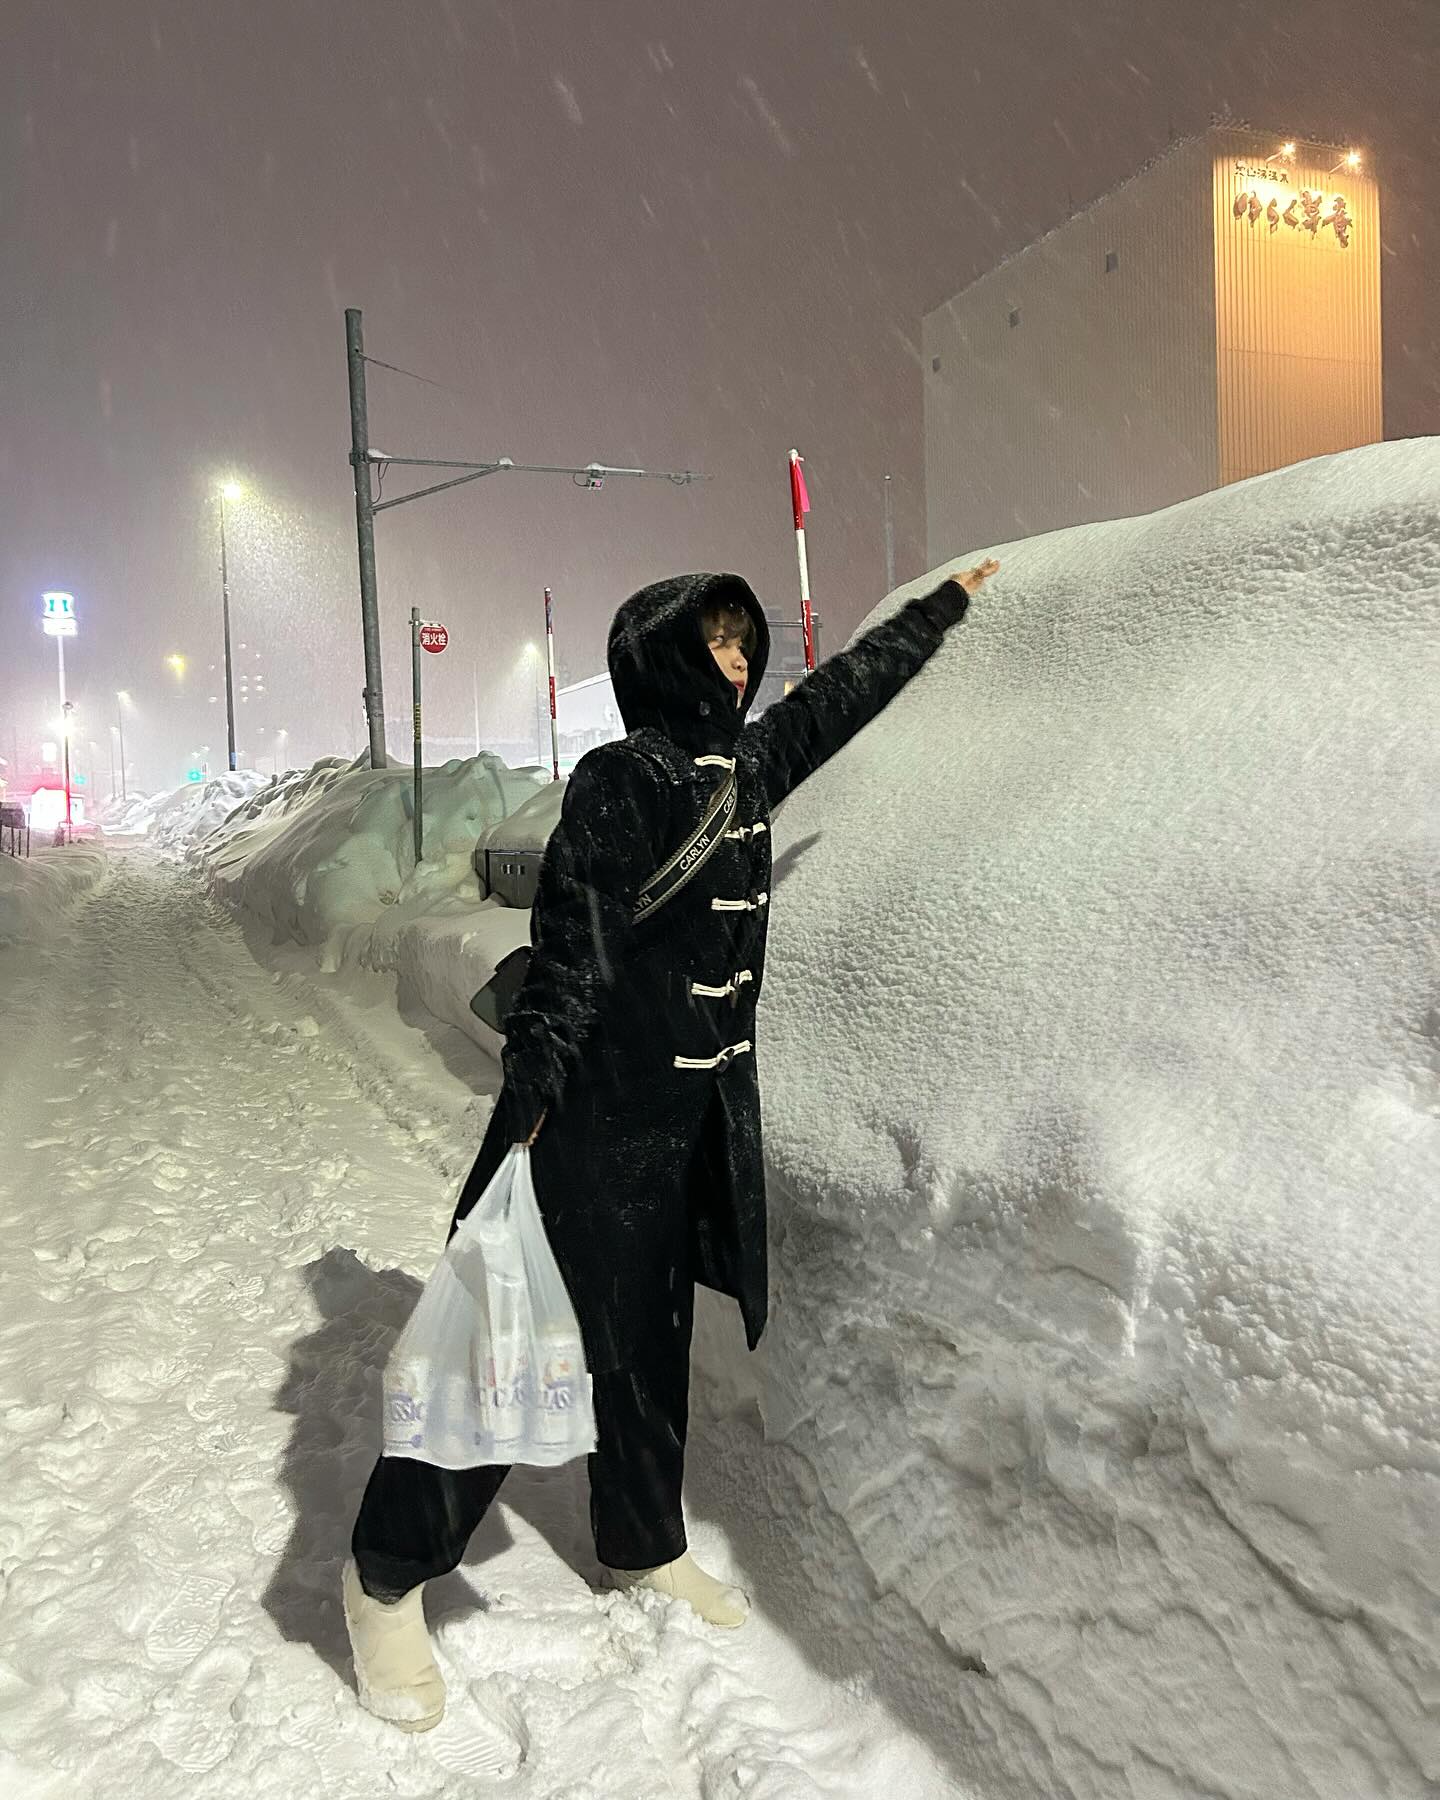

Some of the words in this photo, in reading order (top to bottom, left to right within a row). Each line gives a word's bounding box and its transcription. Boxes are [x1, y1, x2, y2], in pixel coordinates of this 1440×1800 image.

[421, 632, 446, 645] 消火栓
[680, 834, 710, 870] CARLYN
